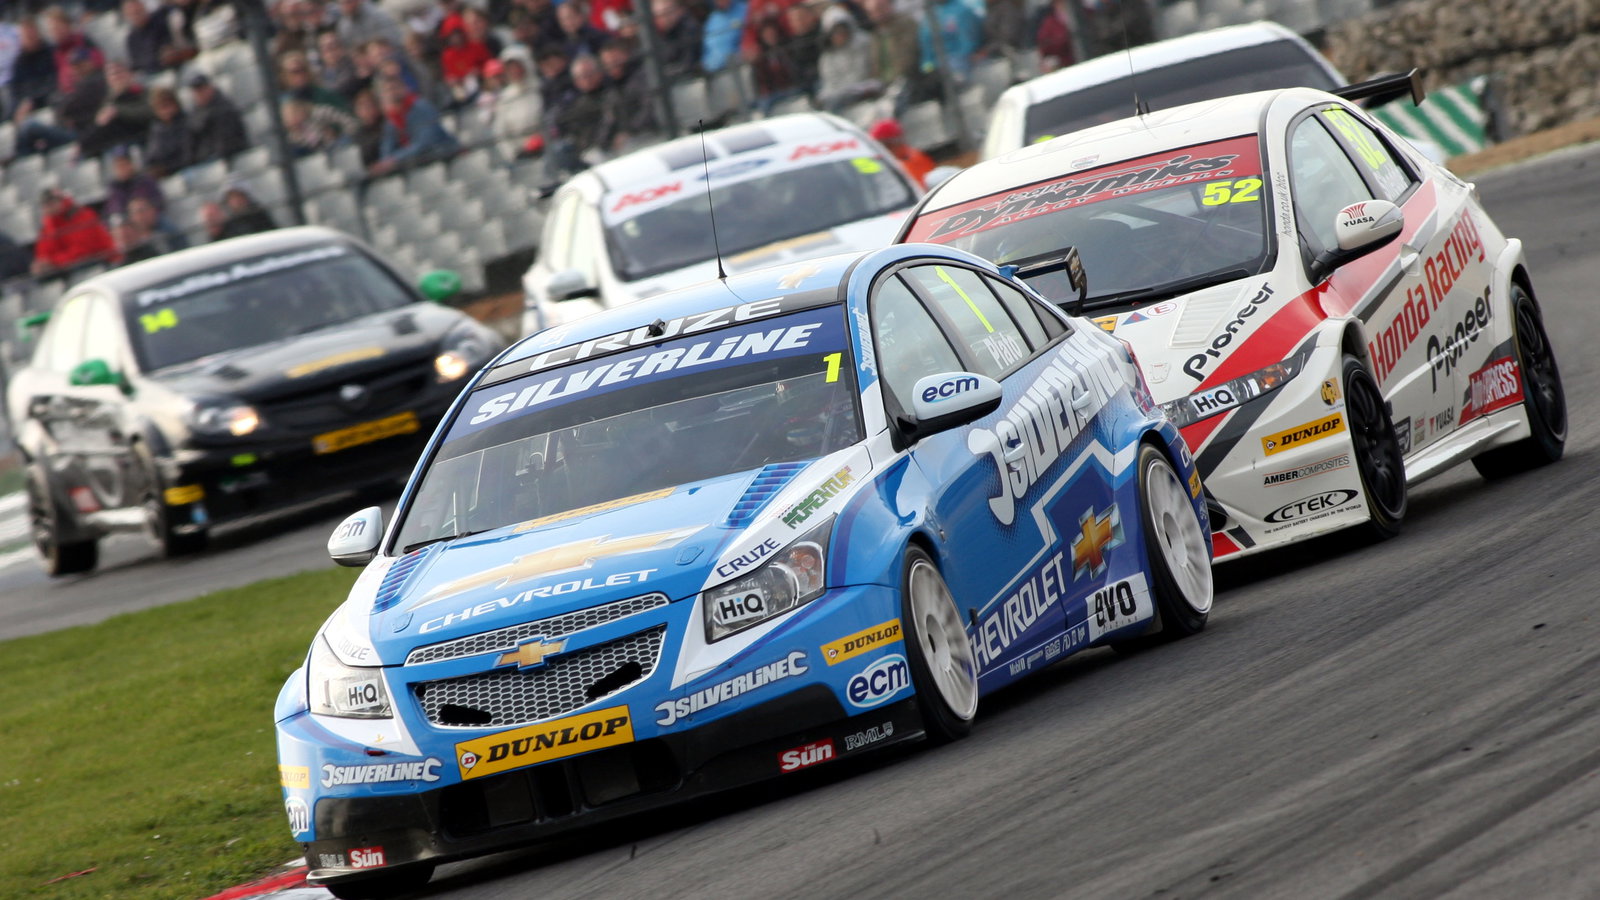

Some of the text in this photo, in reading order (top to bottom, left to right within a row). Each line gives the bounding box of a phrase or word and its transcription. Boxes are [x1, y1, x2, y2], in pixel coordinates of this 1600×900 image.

[924, 154, 1240, 242] Dynamics
[1201, 179, 1263, 206] 52
[1343, 216, 1375, 227] YUASA
[935, 265, 995, 332] 1
[1368, 207, 1486, 388] Honda Racing
[529, 296, 785, 371] CRUZE
[1183, 282, 1274, 382] Pioneer
[1427, 285, 1493, 394] Pioneer
[983, 332, 1022, 370] Plato
[822, 352, 842, 383] 1
[922, 377, 979, 403] ecm
[1193, 389, 1235, 412] HiQ
[1281, 418, 1340, 446] DUNLOP
[1281, 494, 1335, 519] CTEK
[716, 537, 781, 578] CRUZE
[418, 568, 658, 634] CHEVROLET
[719, 593, 765, 620] HiQ
[843, 624, 900, 653] DUNLOP
[348, 683, 377, 706] HiQ
[850, 661, 908, 703] ecm
[486, 715, 628, 763] DUNLOP
[845, 726, 886, 750] RML
[782, 744, 832, 770] Sun
[351, 850, 383, 868] Sun
